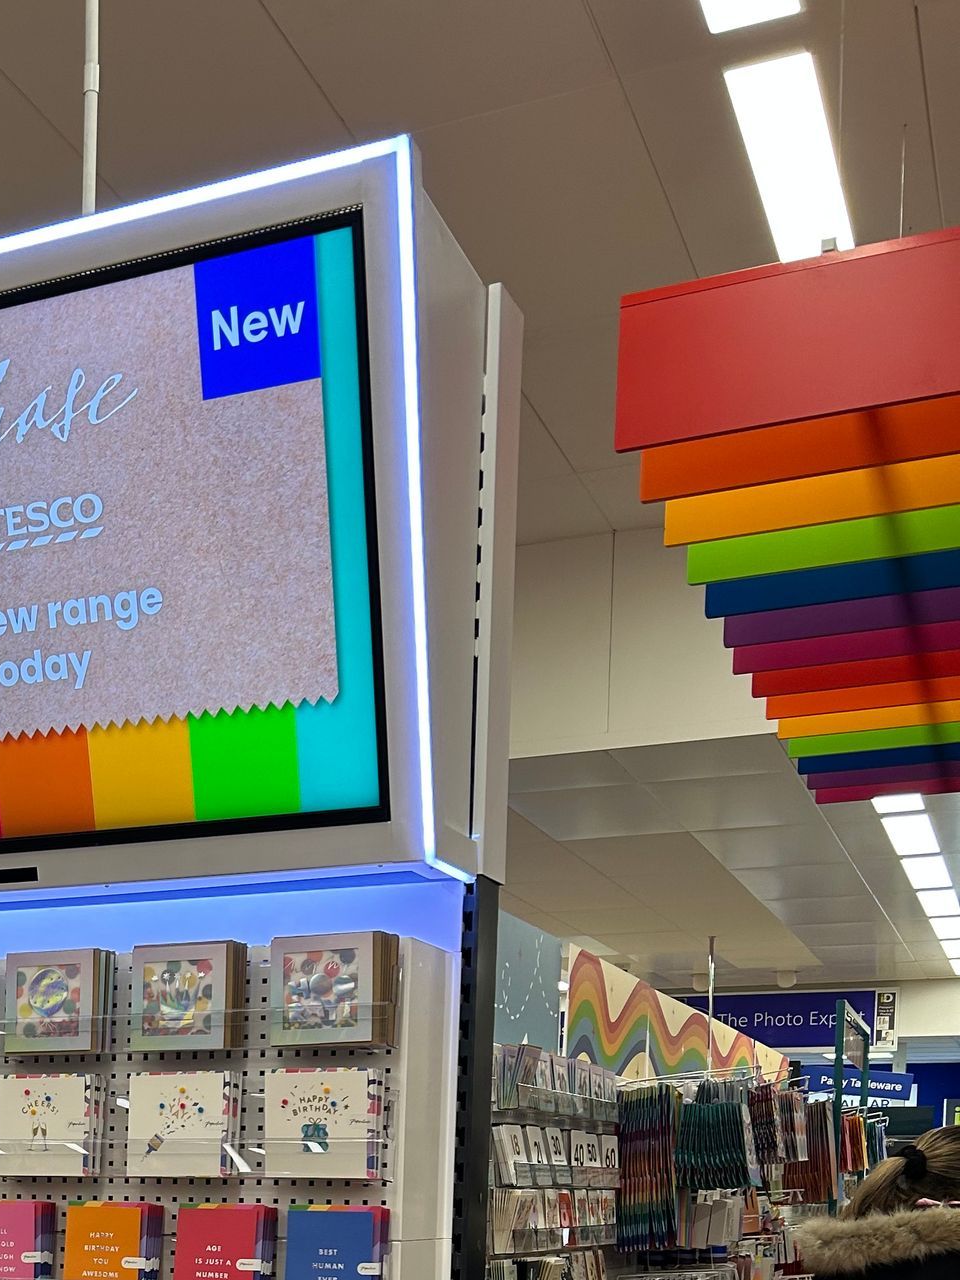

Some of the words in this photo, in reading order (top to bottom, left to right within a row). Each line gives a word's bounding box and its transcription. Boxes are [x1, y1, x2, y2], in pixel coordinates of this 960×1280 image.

[211, 300, 305, 350] New
[48, 584, 164, 637] range
[717, 1012, 748, 1027] The
[753, 1012, 804, 1027] Photo
[809, 1011, 866, 1028] Expt
[820, 1076, 848, 1089] Pay
[850, 1078, 903, 1092] Taleware
[299, 1095, 330, 1104] HAPPY
[21, 1099, 60, 1116] CHEERS!
[292, 1103, 339, 1117] BIRTHDAY
[509, 1134, 521, 1156] 18
[551, 1136, 562, 1156] 30
[573, 1143, 585, 1167] 40
[586, 1143, 597, 1163] 50
[604, 1148, 616, 1168] 60
[89, 1231, 114, 1240] HAPPY
[0, 1240, 15, 1248] OLD
[84, 1244, 120, 1253] BIRTHDAY
[205, 1244, 222, 1253] AGE
[318, 1248, 338, 1257] BEST
[93, 1257, 109, 1265] YOU
[195, 1257, 203, 1265] IS
[205, 1257, 224, 1266] JUST
[311, 1262, 345, 1271] HUMAN
[82, 1270, 119, 1278] AWESOME
[195, 1271, 229, 1280] NUMBER
